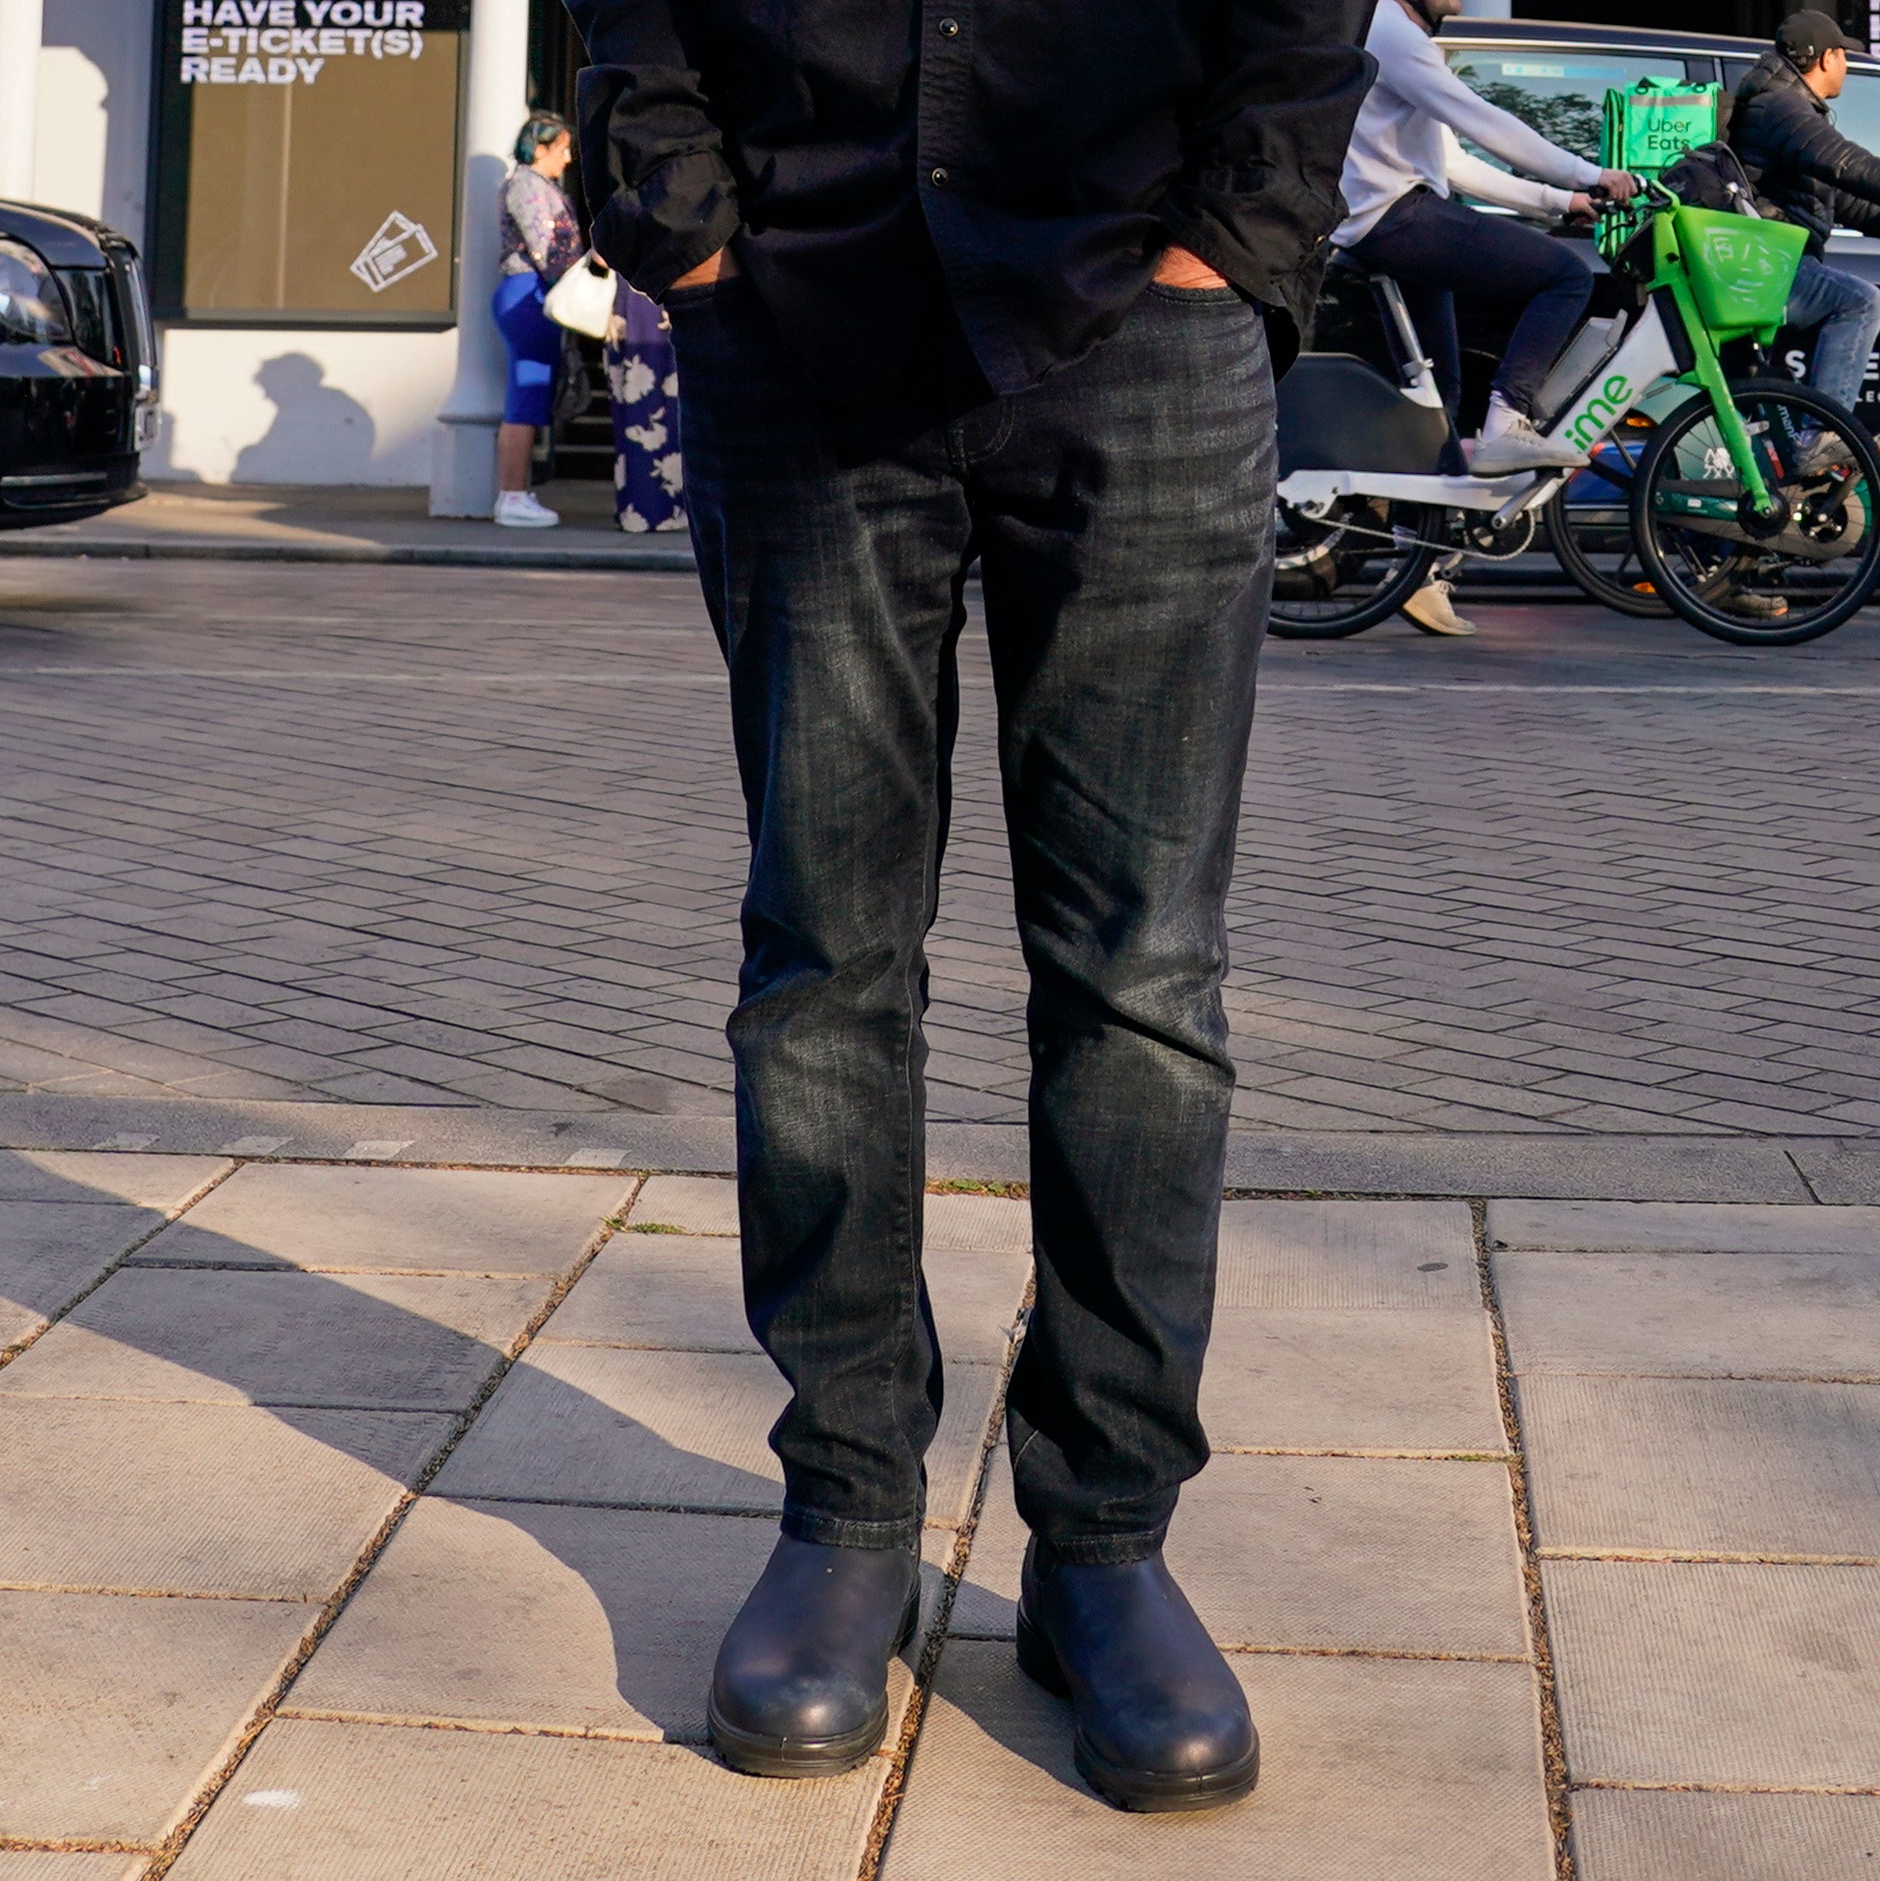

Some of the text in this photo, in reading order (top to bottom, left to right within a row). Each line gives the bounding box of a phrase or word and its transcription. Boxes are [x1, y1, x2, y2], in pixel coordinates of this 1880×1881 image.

[182, 0, 426, 28] HAVE YOUR
[181, 27, 423, 60] E-TICKET(S)
[180, 57, 324, 84] READY
[1647, 119, 1692, 133] Uber
[1564, 374, 1634, 454] ime
